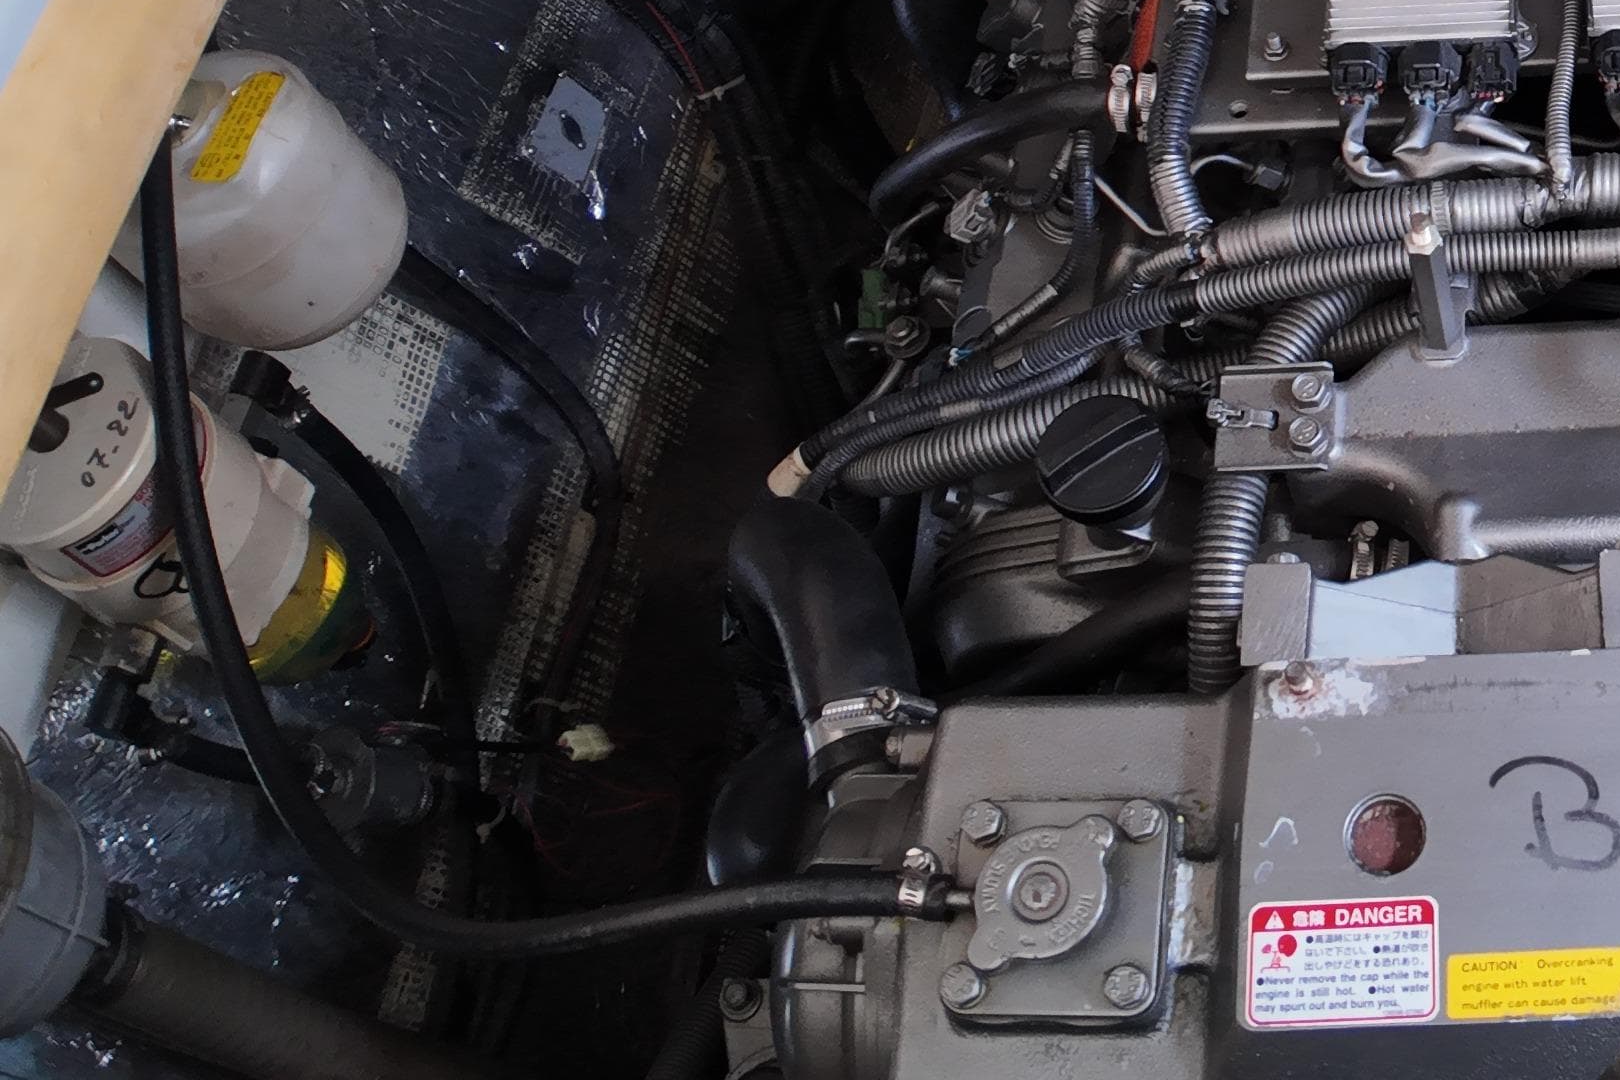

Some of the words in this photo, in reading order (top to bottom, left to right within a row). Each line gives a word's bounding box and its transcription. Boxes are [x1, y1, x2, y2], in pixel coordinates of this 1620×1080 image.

[1334, 905, 1422, 926] DANGER
[1461, 961, 1518, 973] CAUTION
[1537, 957, 1614, 969] Overcranking
[1265, 975, 1295, 985] Never
[1298, 974, 1337, 984] remove
[1340, 973, 1356, 982] the
[1360, 974, 1379, 983] cap
[1383, 971, 1410, 980] while
[1414, 969, 1429, 979] the
[1462, 982, 1499, 992] engine
[1503, 980, 1528, 989] with
[1532, 978, 1566, 988] water
[1570, 977, 1587, 986] lift
[1255, 990, 1290, 1001] engine
[1296, 988, 1304, 997] is
[1311, 986, 1330, 996] still
[1377, 985, 1395, 994] Hot
[1401, 984, 1429, 993] water
[1255, 1004, 1276, 1014] may
[1280, 1002, 1306, 1013] spurt
[1309, 1001, 1326, 1011] out
[1328, 1000, 1348, 1010] and
[1350, 999, 1375, 1009] burn
[1462, 999, 1503, 1010] muffler
[1507, 1000, 1528, 1008] can
[1533, 997, 1567, 1007] cause
